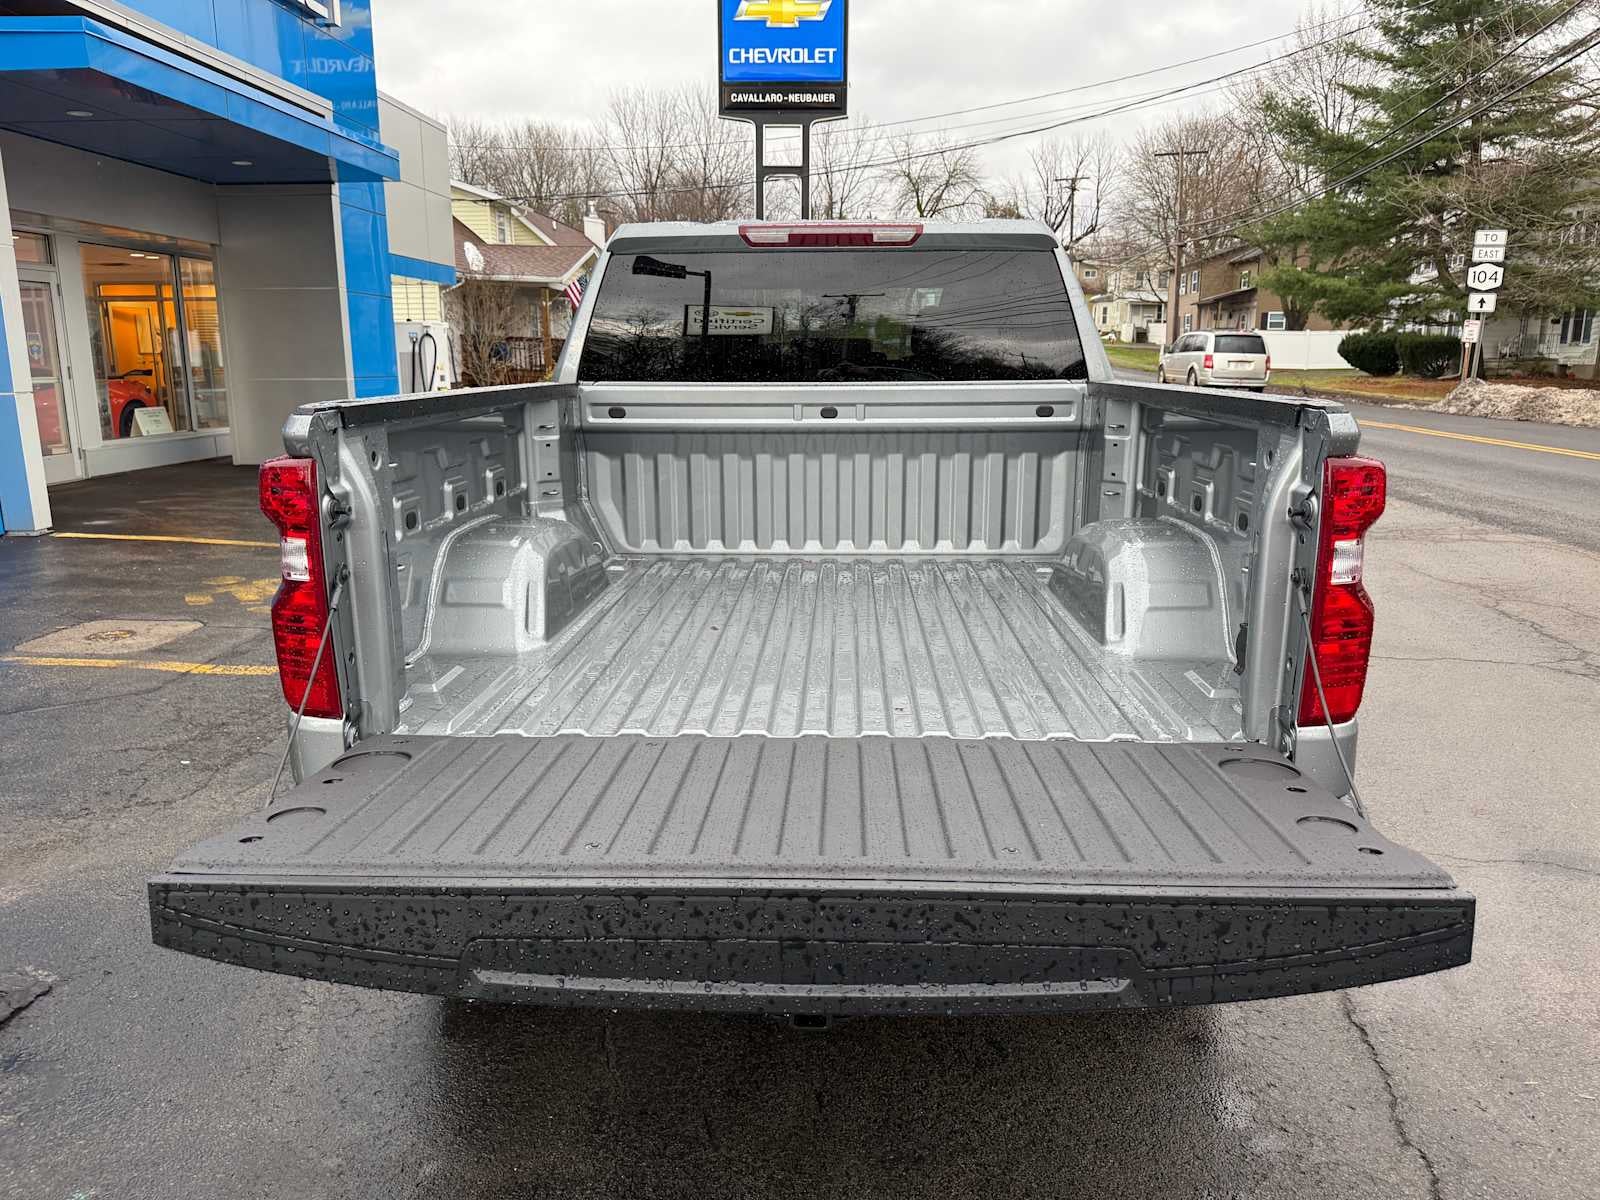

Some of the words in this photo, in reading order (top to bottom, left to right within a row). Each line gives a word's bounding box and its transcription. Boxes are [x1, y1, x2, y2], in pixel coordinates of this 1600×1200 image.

[728, 48, 837, 64] CHEVROLET
[730, 93, 836, 103] CAVALLARO-NEUBAUER
[1484, 233, 1498, 242] TO
[1478, 249, 1500, 259] EAST
[1472, 270, 1499, 284] 104
